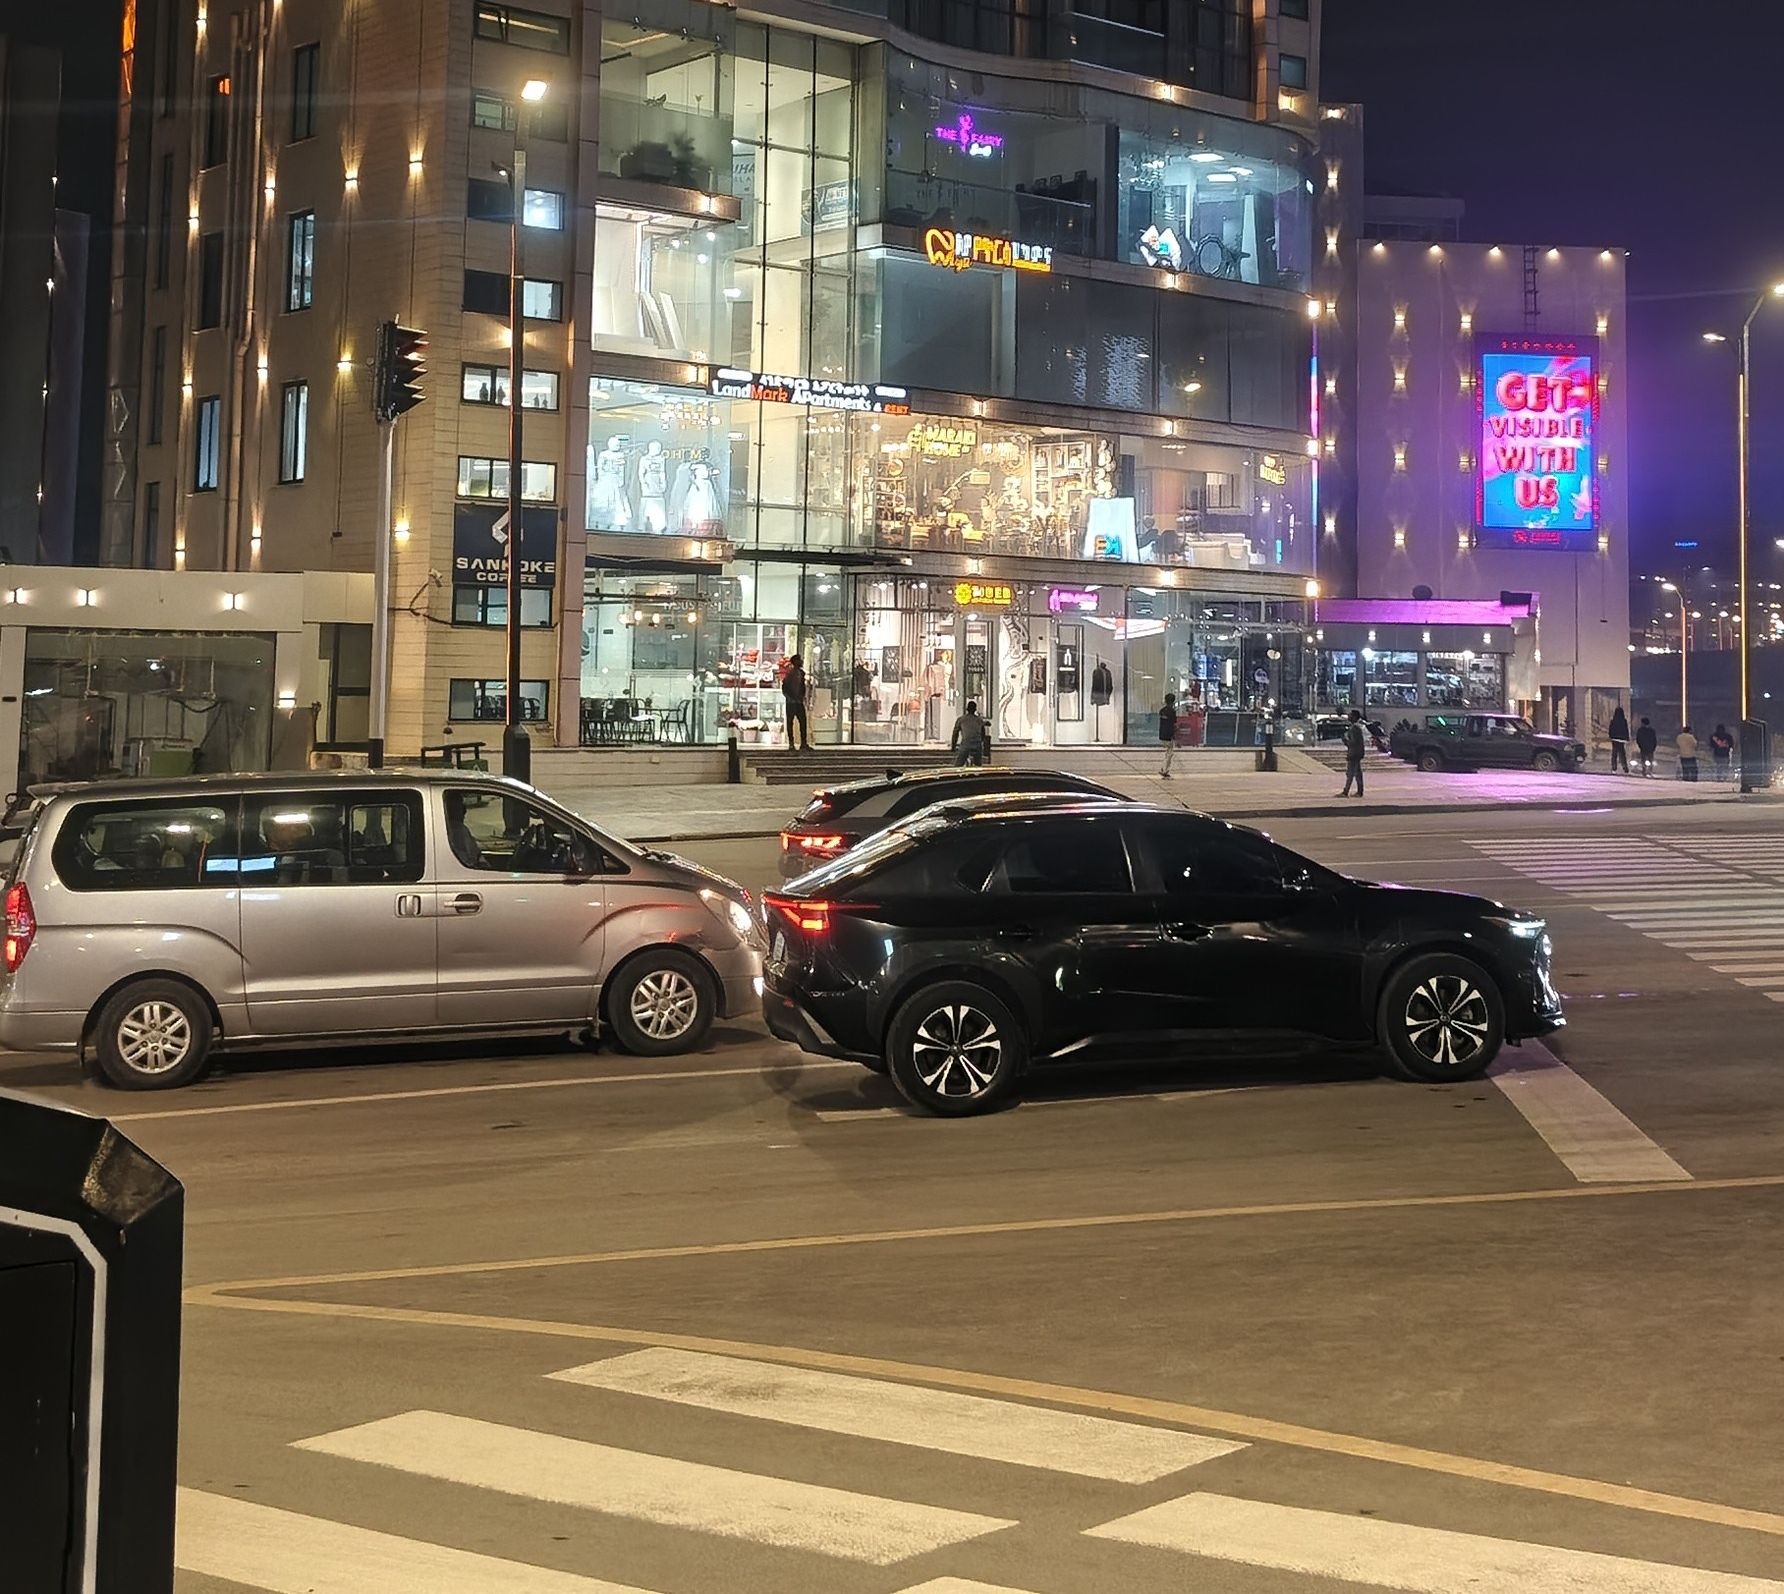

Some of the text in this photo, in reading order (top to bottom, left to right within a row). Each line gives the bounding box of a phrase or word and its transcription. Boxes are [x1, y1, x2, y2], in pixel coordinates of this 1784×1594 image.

[1496, 373, 1572, 413] GET
[1489, 416, 1584, 439] VISIBLE
[1493, 445, 1577, 474] WITH
[1514, 477, 1560, 510] US
